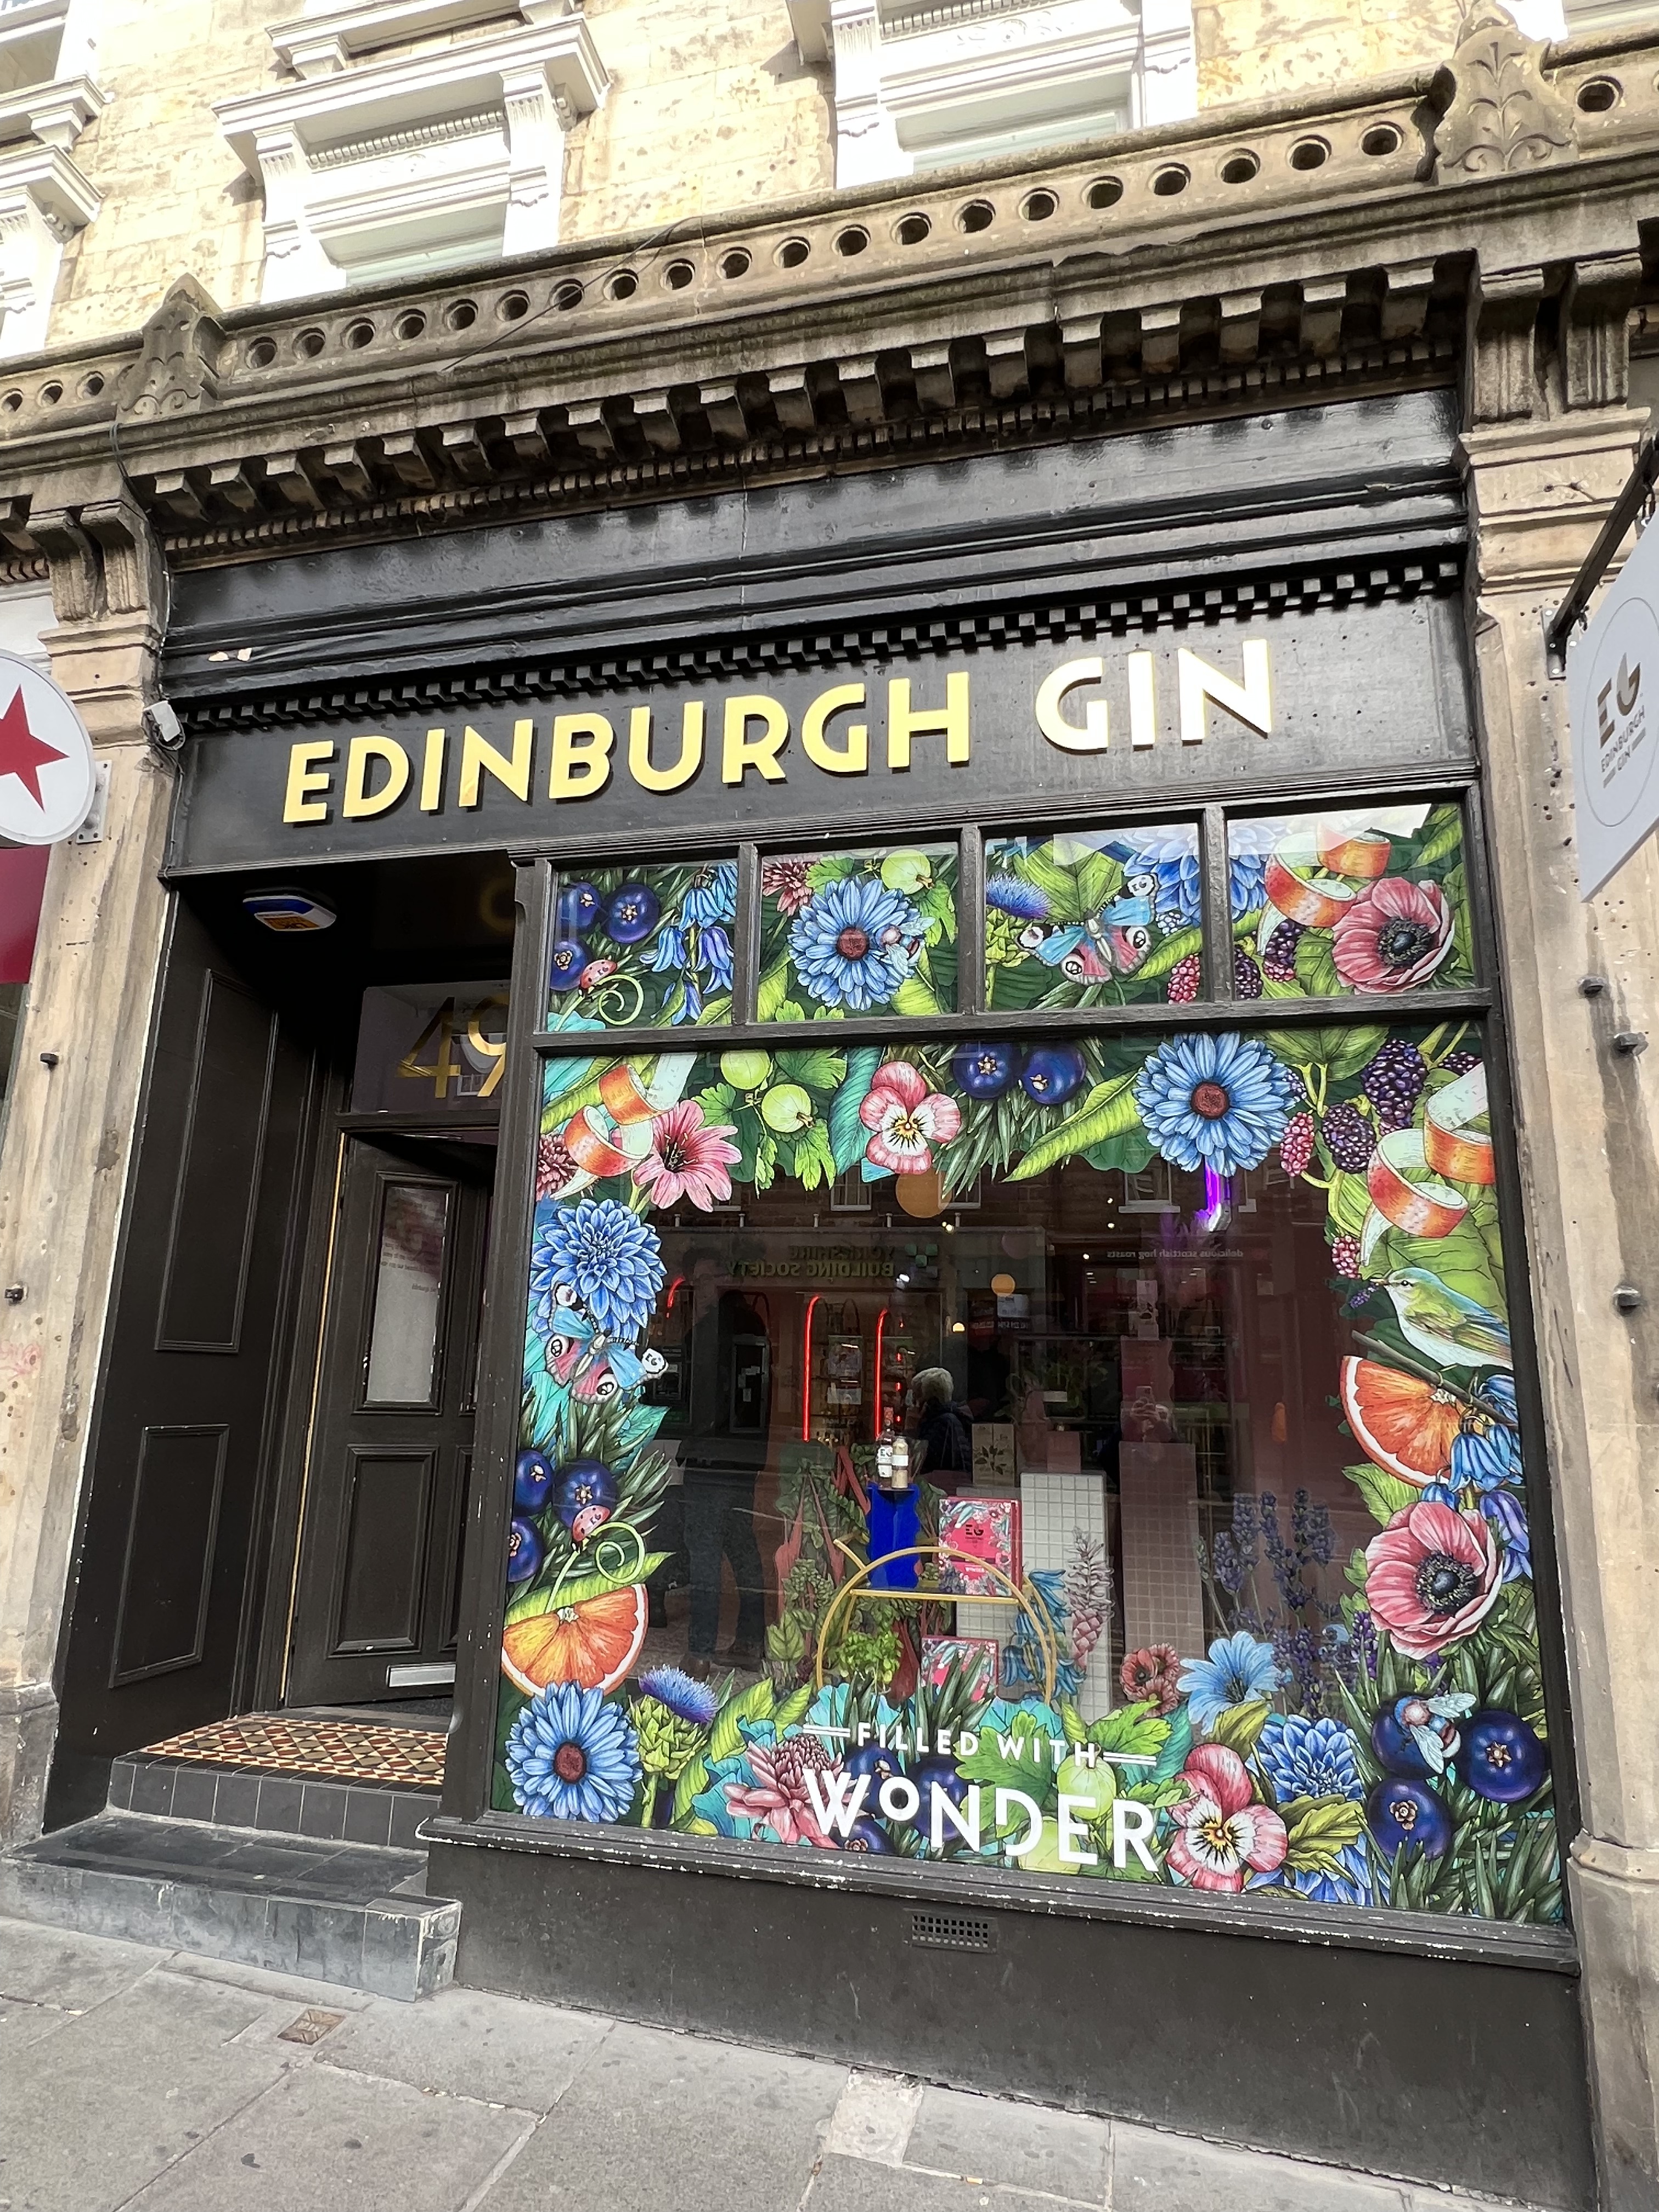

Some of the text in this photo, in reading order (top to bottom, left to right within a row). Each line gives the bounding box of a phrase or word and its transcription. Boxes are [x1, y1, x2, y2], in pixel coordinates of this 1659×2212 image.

[282, 639, 1273, 825] EDINBURGH GIN
[1601, 705, 1645, 772] EDINBURGH
[1617, 744, 1631, 770] GIN
[397, 995, 509, 1097] 49
[858, 1723, 1096, 1768] FILLED WITH
[803, 1769, 1159, 1871] WONDER
